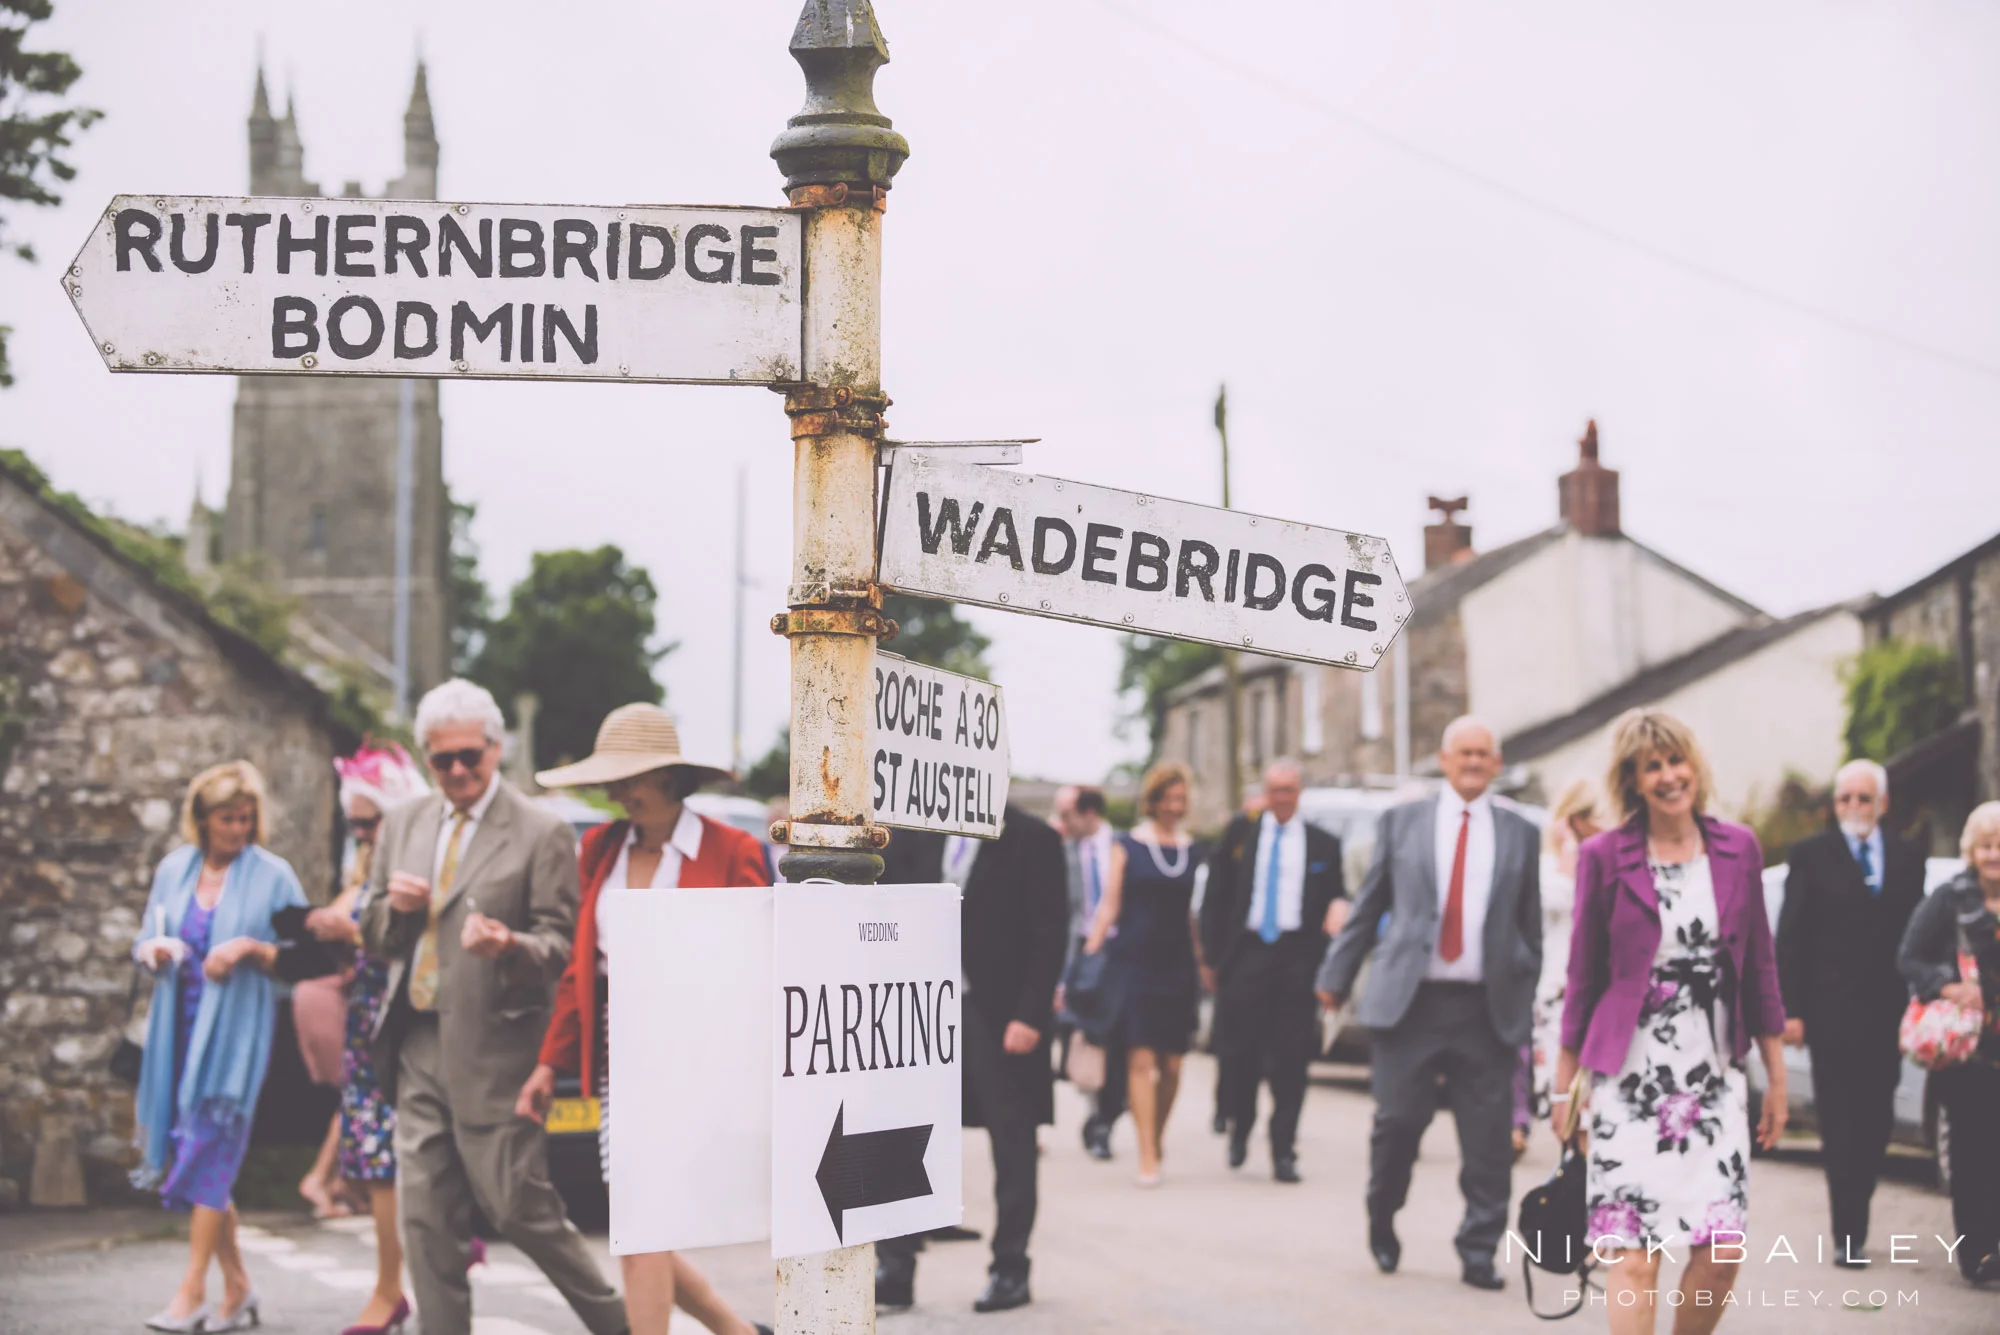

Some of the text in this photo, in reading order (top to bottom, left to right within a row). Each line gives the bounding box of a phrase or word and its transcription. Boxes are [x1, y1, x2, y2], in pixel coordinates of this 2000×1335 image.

[114, 208, 781, 286] RUTHERNBRIDGE
[271, 295, 598, 365] BODMIN
[915, 491, 1382, 631] WADEBRIDGE
[874, 748, 996, 826] ST AUSTELL
[858, 922, 899, 942] WEDDING
[782, 979, 956, 1077] PARKING
